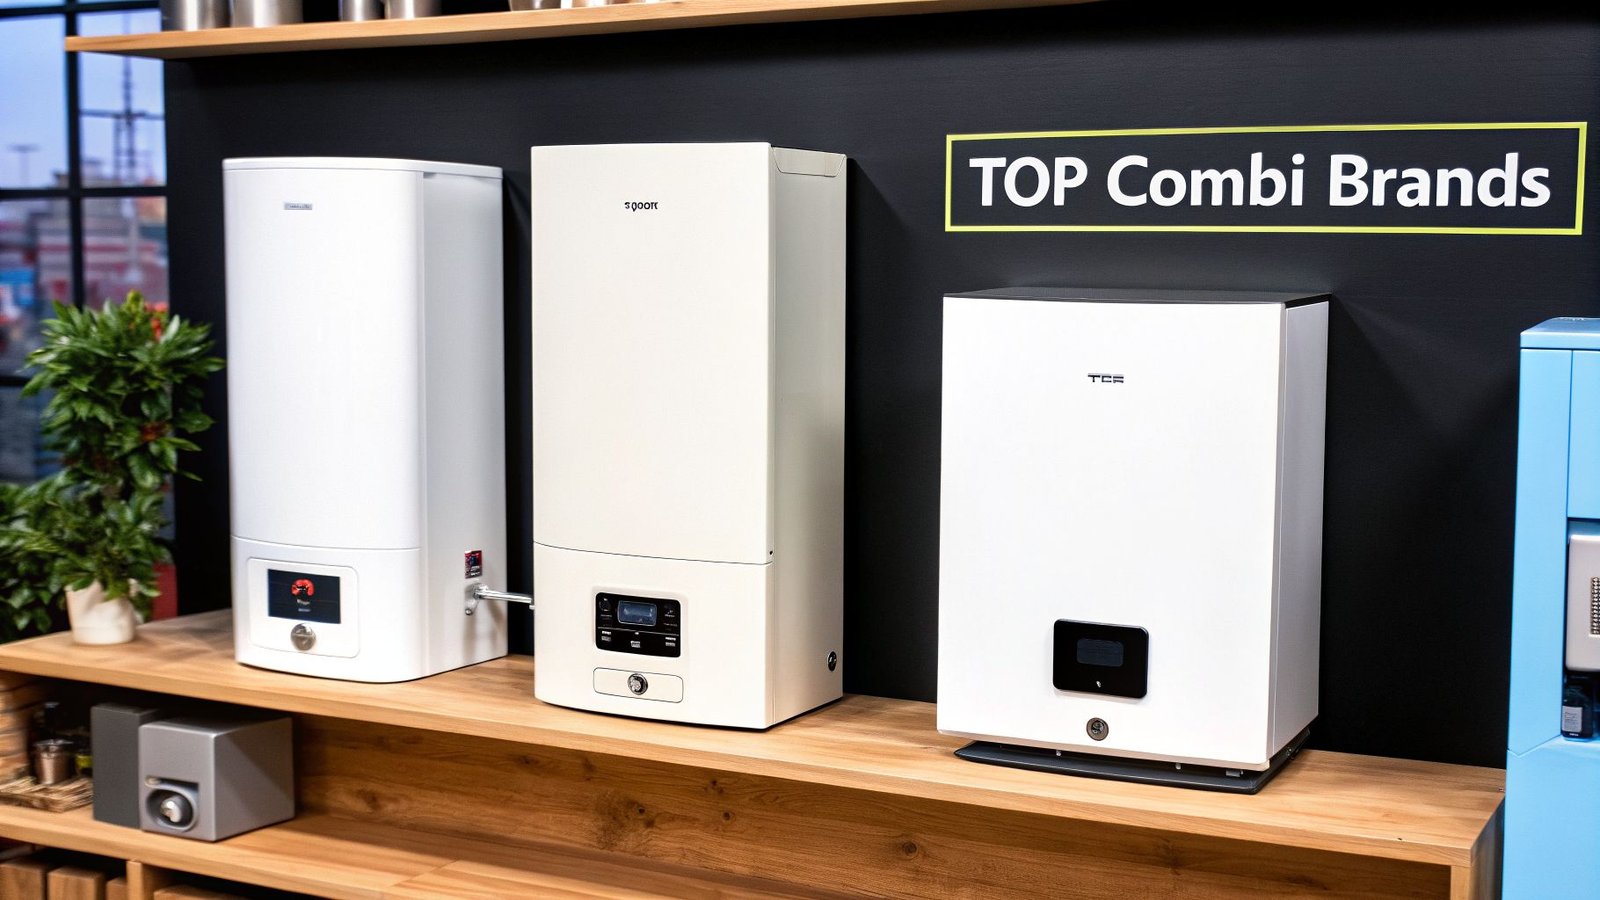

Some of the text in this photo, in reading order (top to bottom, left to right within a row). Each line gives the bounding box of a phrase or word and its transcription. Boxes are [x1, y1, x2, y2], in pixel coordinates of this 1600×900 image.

[968, 152, 1551, 207] TOP Combi Brands
